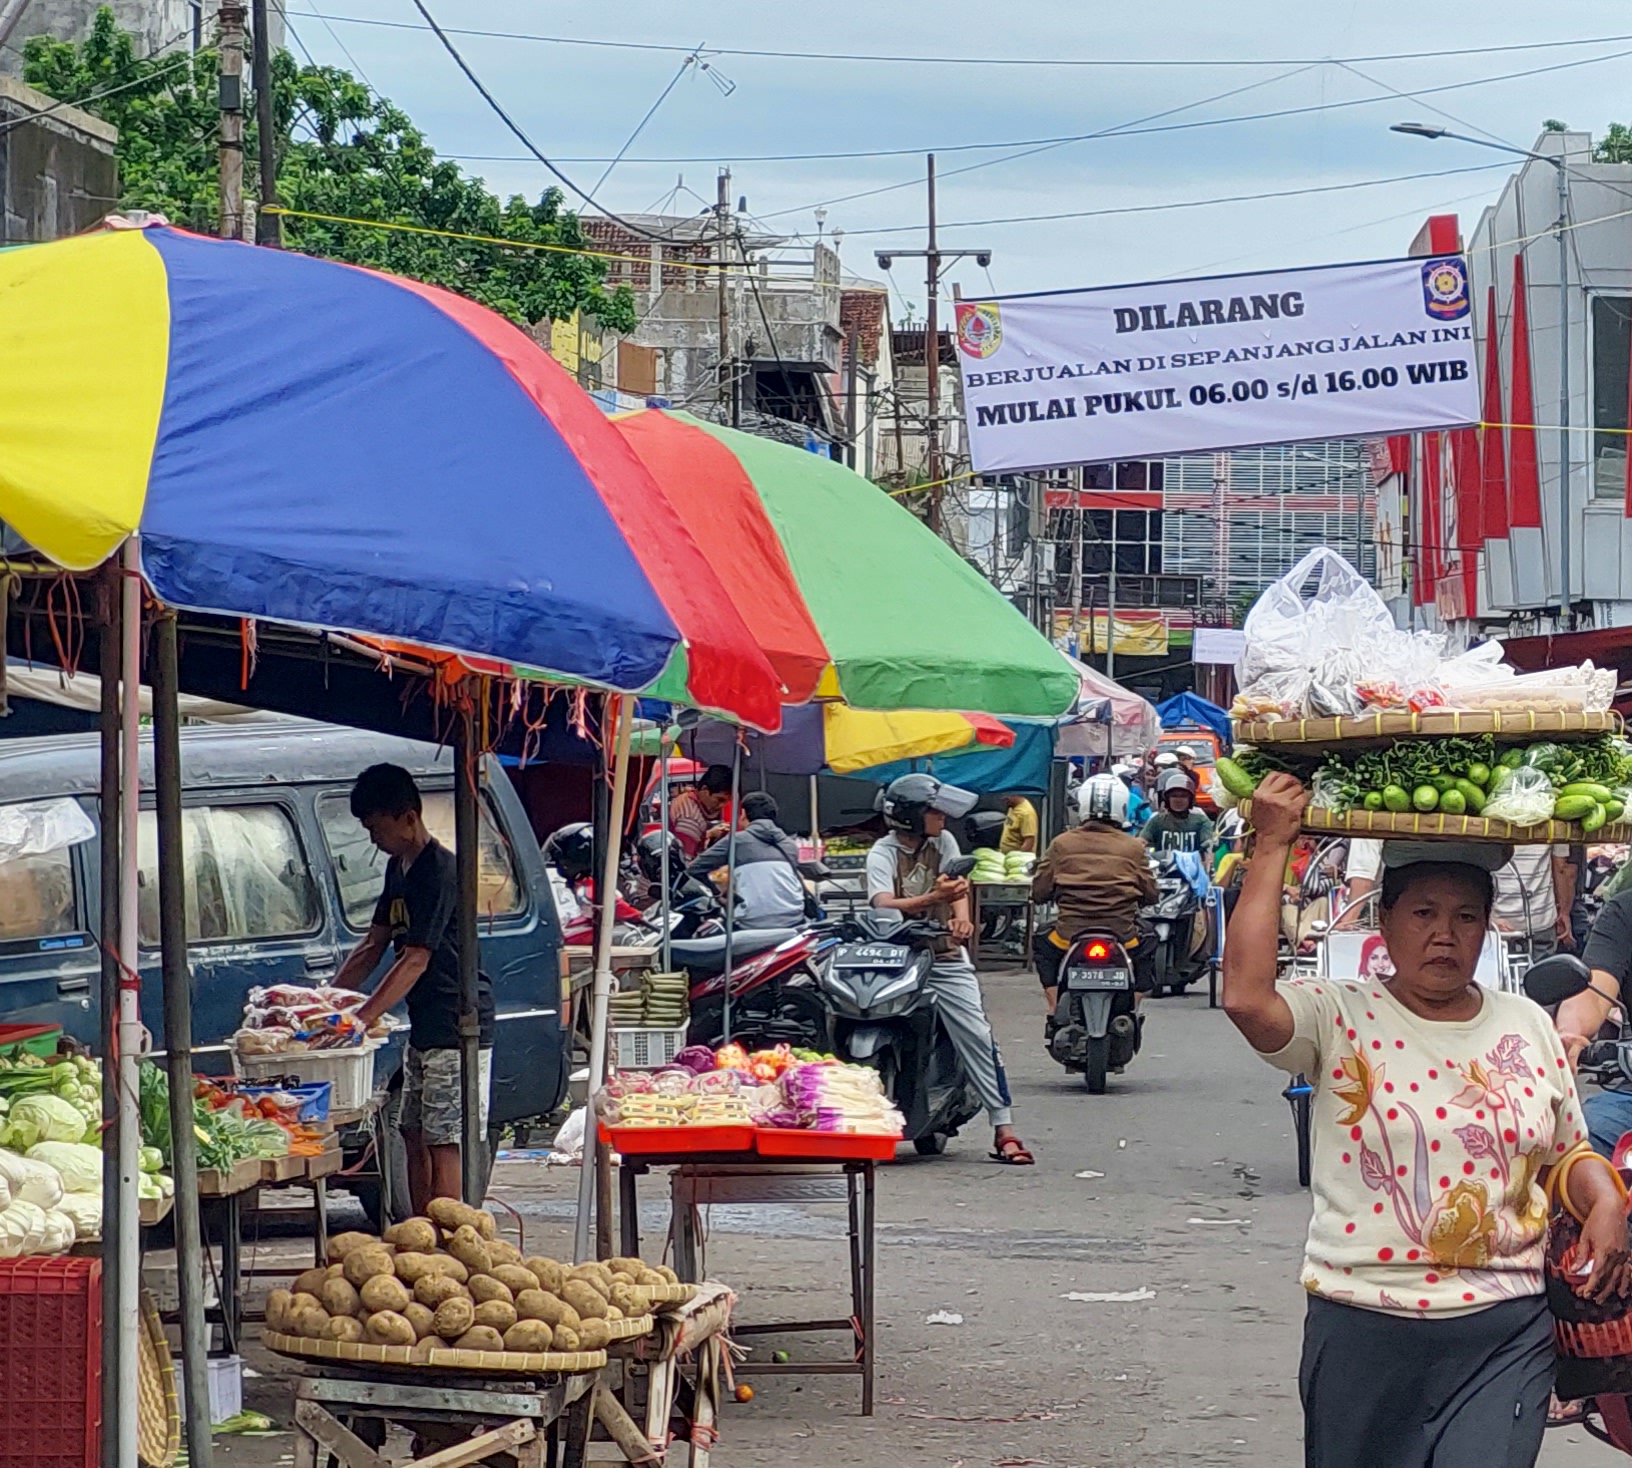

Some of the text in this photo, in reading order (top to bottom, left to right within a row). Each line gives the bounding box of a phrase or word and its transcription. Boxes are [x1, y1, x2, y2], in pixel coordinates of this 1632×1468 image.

[1113, 291, 1304, 334] DILARANG
[967, 326, 1472, 388] BERJUALAN DI SEPANJANG JALAN INI
[976, 359, 1468, 427] MULAI PUKUL 06.00 s/d 16.00 WIB
